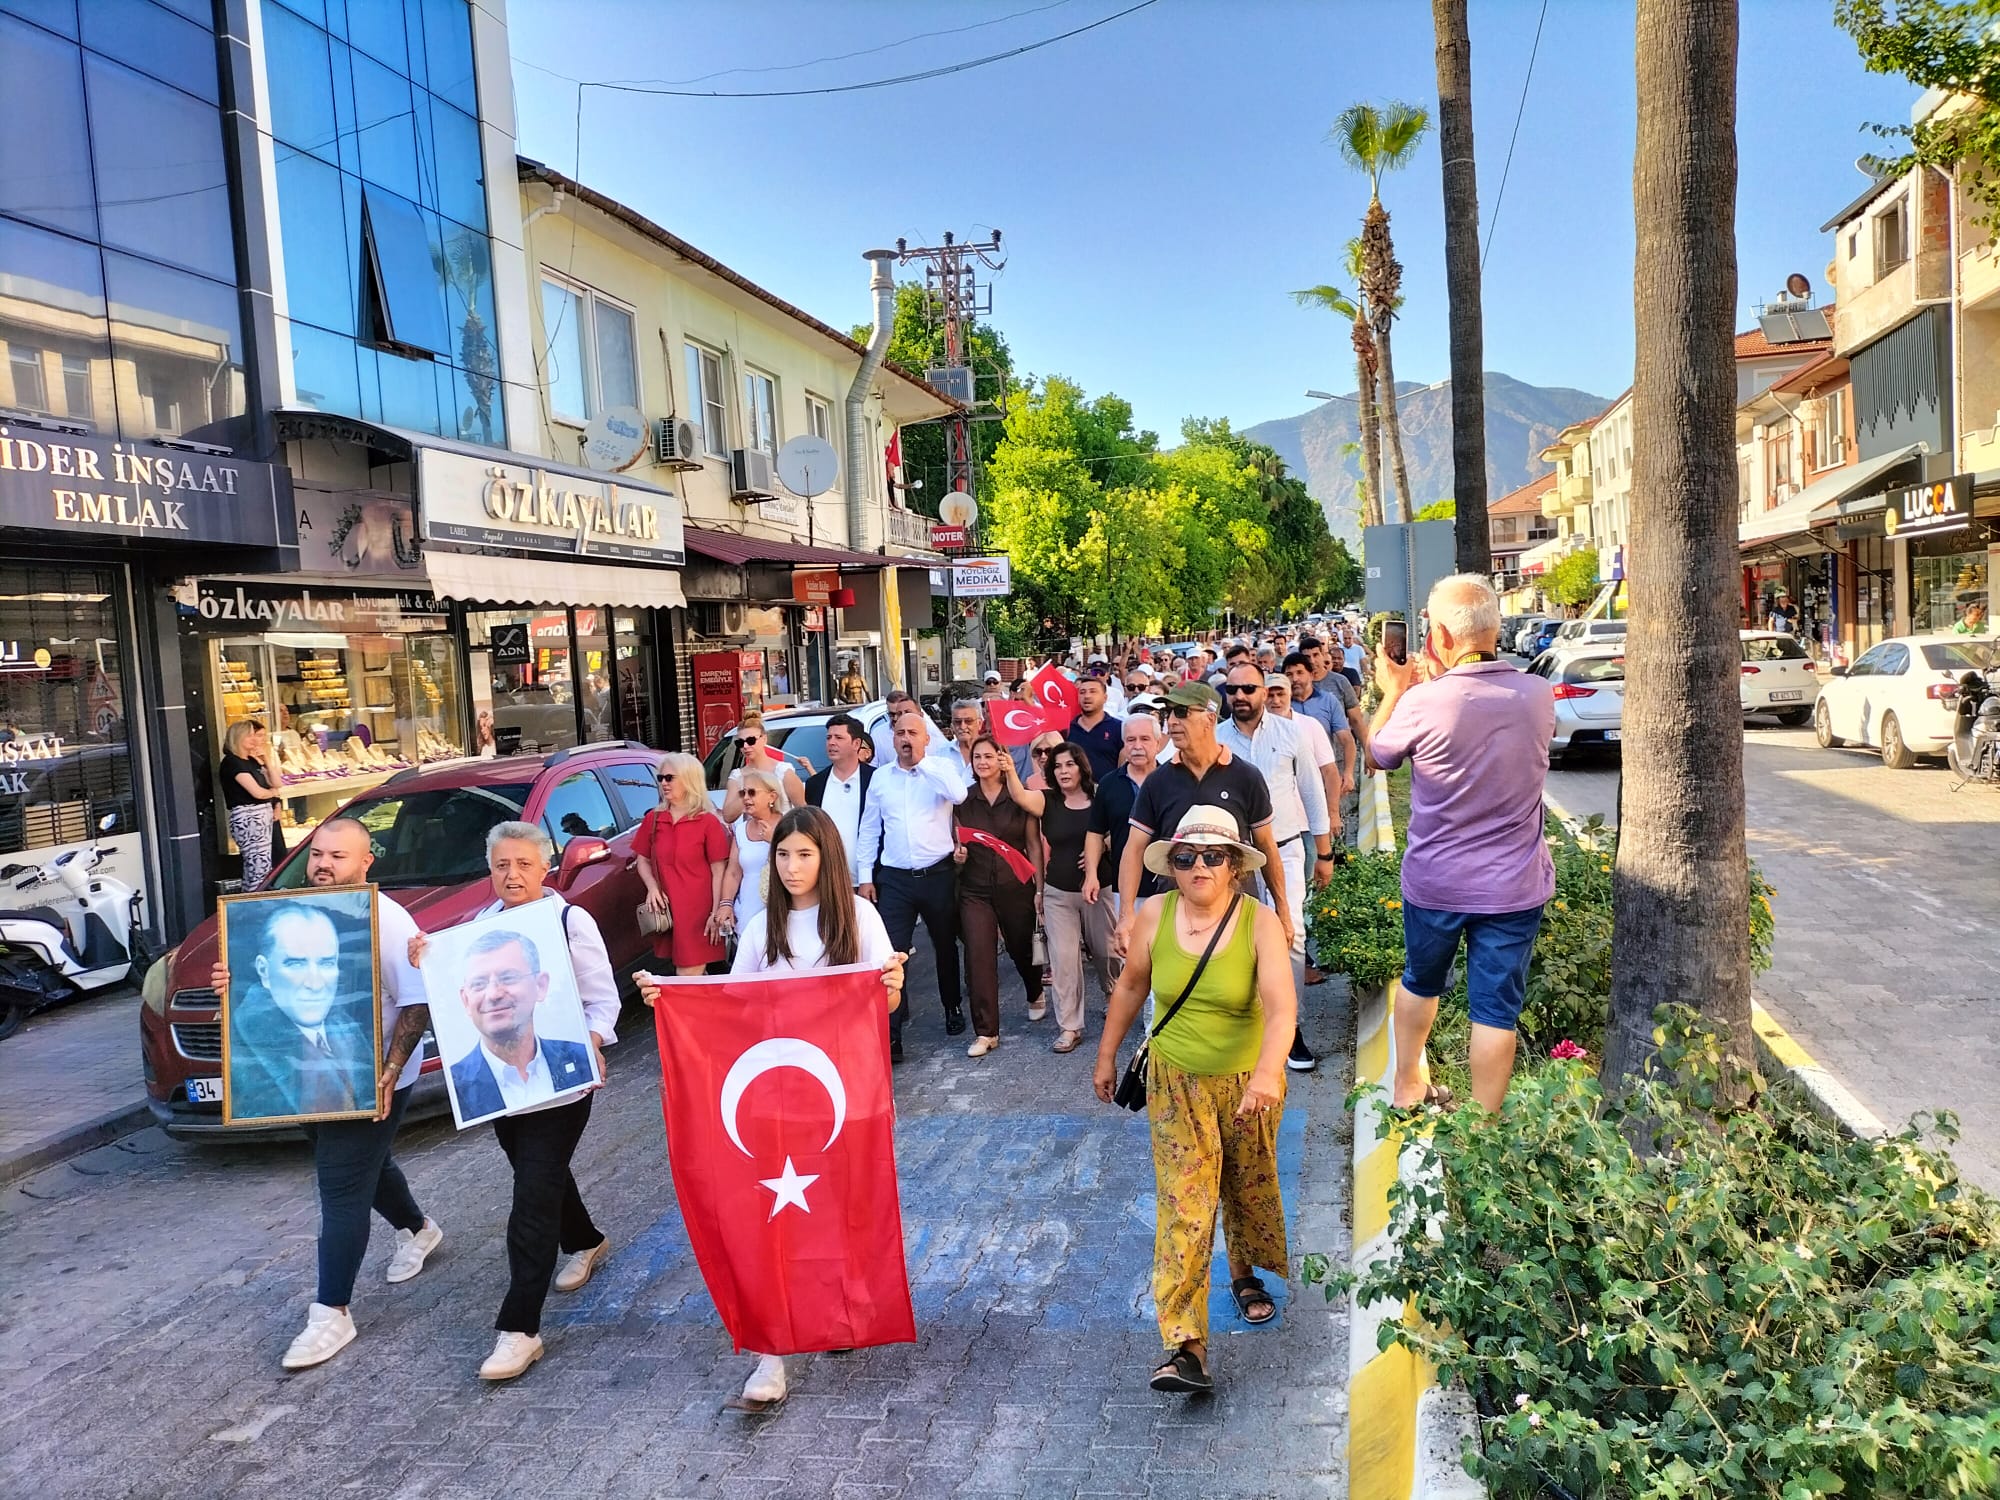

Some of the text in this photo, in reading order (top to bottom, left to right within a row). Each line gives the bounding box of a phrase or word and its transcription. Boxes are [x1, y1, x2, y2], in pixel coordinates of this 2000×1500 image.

[112, 443, 239, 495] İNŞAAT
[52, 489, 189, 531] EMLAK
[484, 466, 660, 552] ÖZKAYALAR
[1904, 482, 1956, 520] LUCCA
[932, 532, 963, 542] NOTER
[200, 587, 345, 628] ÖZKAYALAR
[497, 647, 525, 657] ADN
[196, 1081, 216, 1098] 34
